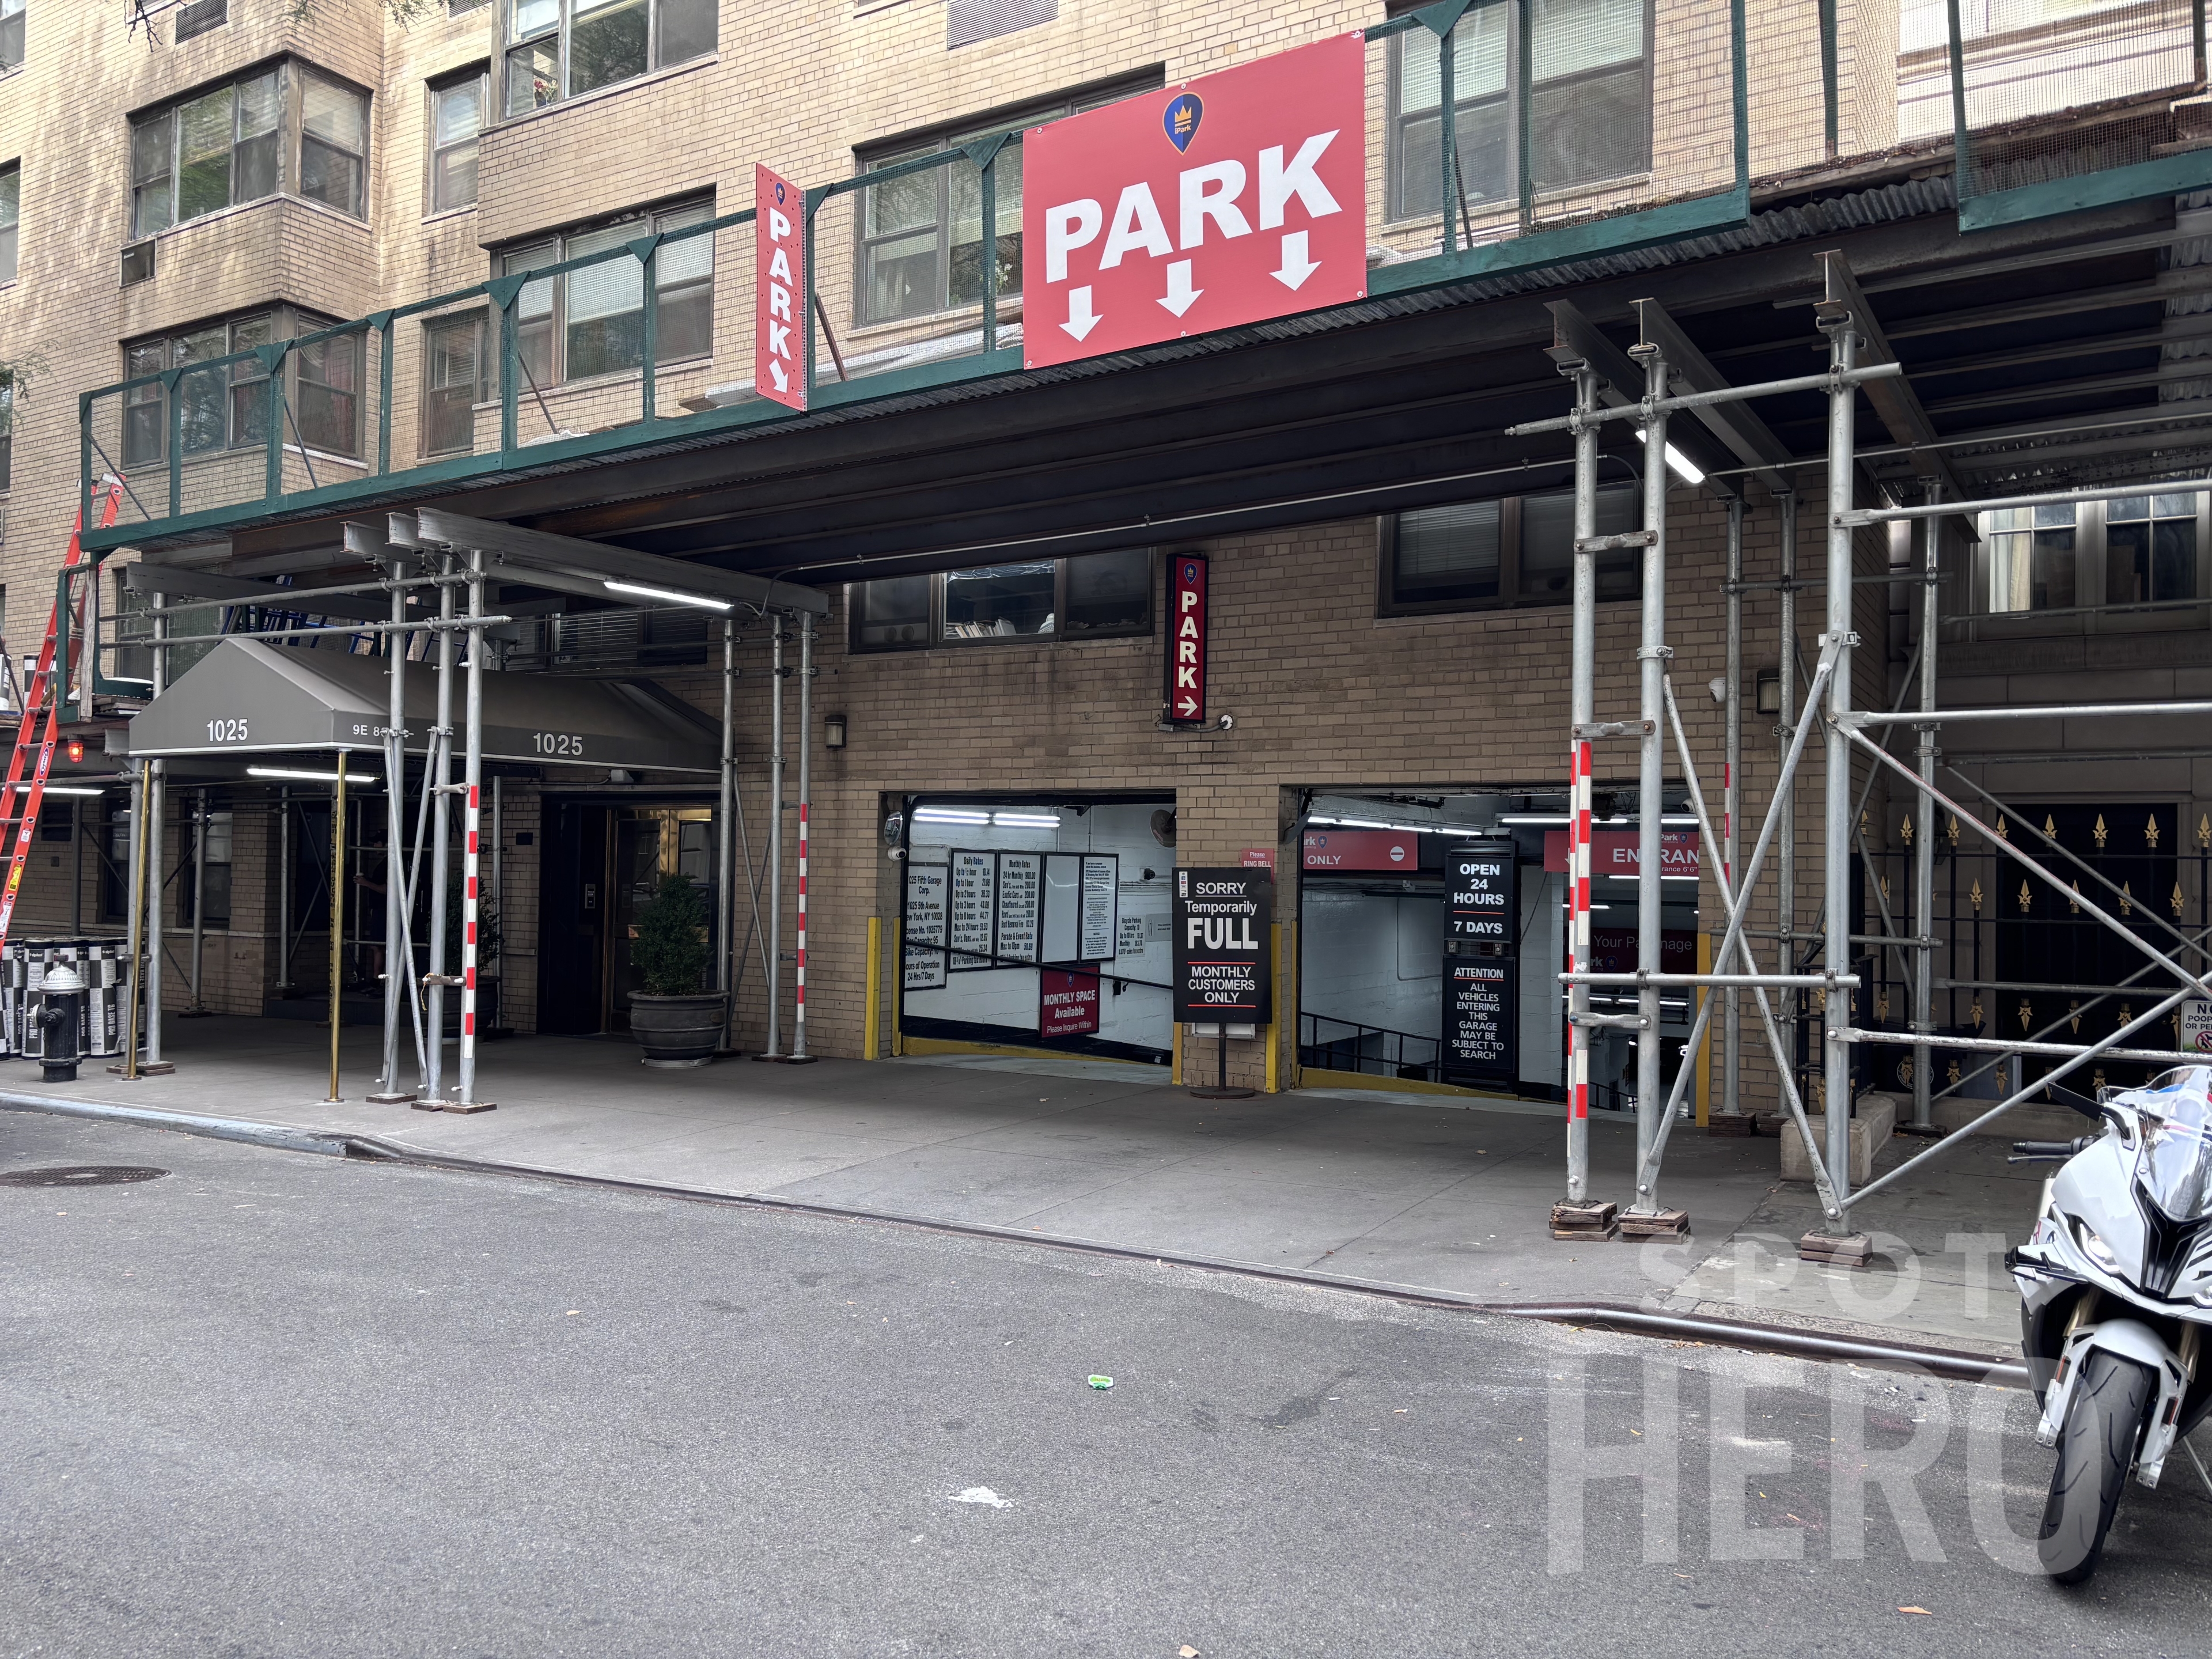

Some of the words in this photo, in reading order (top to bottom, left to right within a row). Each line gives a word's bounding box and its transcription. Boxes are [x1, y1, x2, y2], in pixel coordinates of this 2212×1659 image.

[1175, 124, 1191, 134] iPark
[1046, 129, 1343, 283] PARK
[769, 206, 793, 361] PARK
[1178, 590, 1199, 689] PARK
[206, 718, 248, 742] 1025
[353, 724, 368, 736] 9E
[533, 732, 583, 756] 1025
[1307, 855, 1342, 865] ONLY
[1613, 848, 1699, 864] ENRAN
[1460, 863, 1500, 876] OPEN
[908, 876, 916, 884] 025
[918, 876, 926, 884] Fifth
[927, 876, 942, 886] Garage
[1470, 878, 1488, 890] 24
[919, 885, 930, 896] Corp.
[967, 889, 976, 897] hours
[1196, 882, 1247, 895] SORRY
[1453, 892, 1505, 906] HOURS
[907, 901, 917, 910] 1025
[925, 901, 940, 910] Avenue
[960, 901, 963, 909] to
[967, 901, 975, 909] hours
[1184, 900, 1257, 916] Temporarily
[914, 912, 923, 922] York,
[925, 912, 930, 921] NY
[931, 912, 942, 921] 10028
[960, 912, 963, 920] to
[967, 912, 976, 920] hours
[926, 925, 942, 934] 1025779
[962, 923, 965, 931] to
[965, 922, 969, 931] 24
[970, 923, 979, 931] hours
[1454, 921, 1462, 932] 7
[1466, 922, 1503, 934] DAYS
[1001, 932, 1012, 940] Parade
[1016, 932, 1025, 940] Event
[1187, 918, 1259, 949] FULL
[1007, 942, 1011, 950] to
[1594, 935, 1623, 948] Your
[915, 947, 933, 957] Capacity:
[916, 961, 920, 969] of
[921, 960, 940, 971] Operation
[907, 972, 912, 981] 24
[925, 971, 934, 982] Days
[1191, 965, 1251, 978] MONTHLY
[1454, 967, 1504, 979] ATTENTION
[1188, 979, 1255, 991] CUSTOMERS
[1470, 983, 1487, 992] ALL
[1044, 992, 1075, 1006] MONTHLY
[1075, 990, 1096, 1002] SPACE
[1205, 991, 1240, 1003] ONLY
[1458, 992, 1499, 1002] VEHICLES
[1054, 1005, 1085, 1019] Available
[1456, 1001, 1500, 1012] ENTERING
[2197, 1003, 2212, 1014] N
[108, 1012, 116, 1024] BASE
[1469, 1012, 1488, 1021] THIS
[1047, 1025, 1062, 1033] Please
[1063, 1022, 1078, 1032] Inquire
[1078, 1020, 1092, 1029] Within
[1459, 1021, 1498, 1031] GARAGE
[29, 1028, 38, 1039] PRO
[1460, 1030, 1482, 1039] MAY
[1484, 1031, 1496, 1040] BE
[1452, 1039, 1488, 1050] SUBJECT
[1491, 1041, 1504, 1051] TO
[1460, 1050, 1496, 1060] SEARCH
